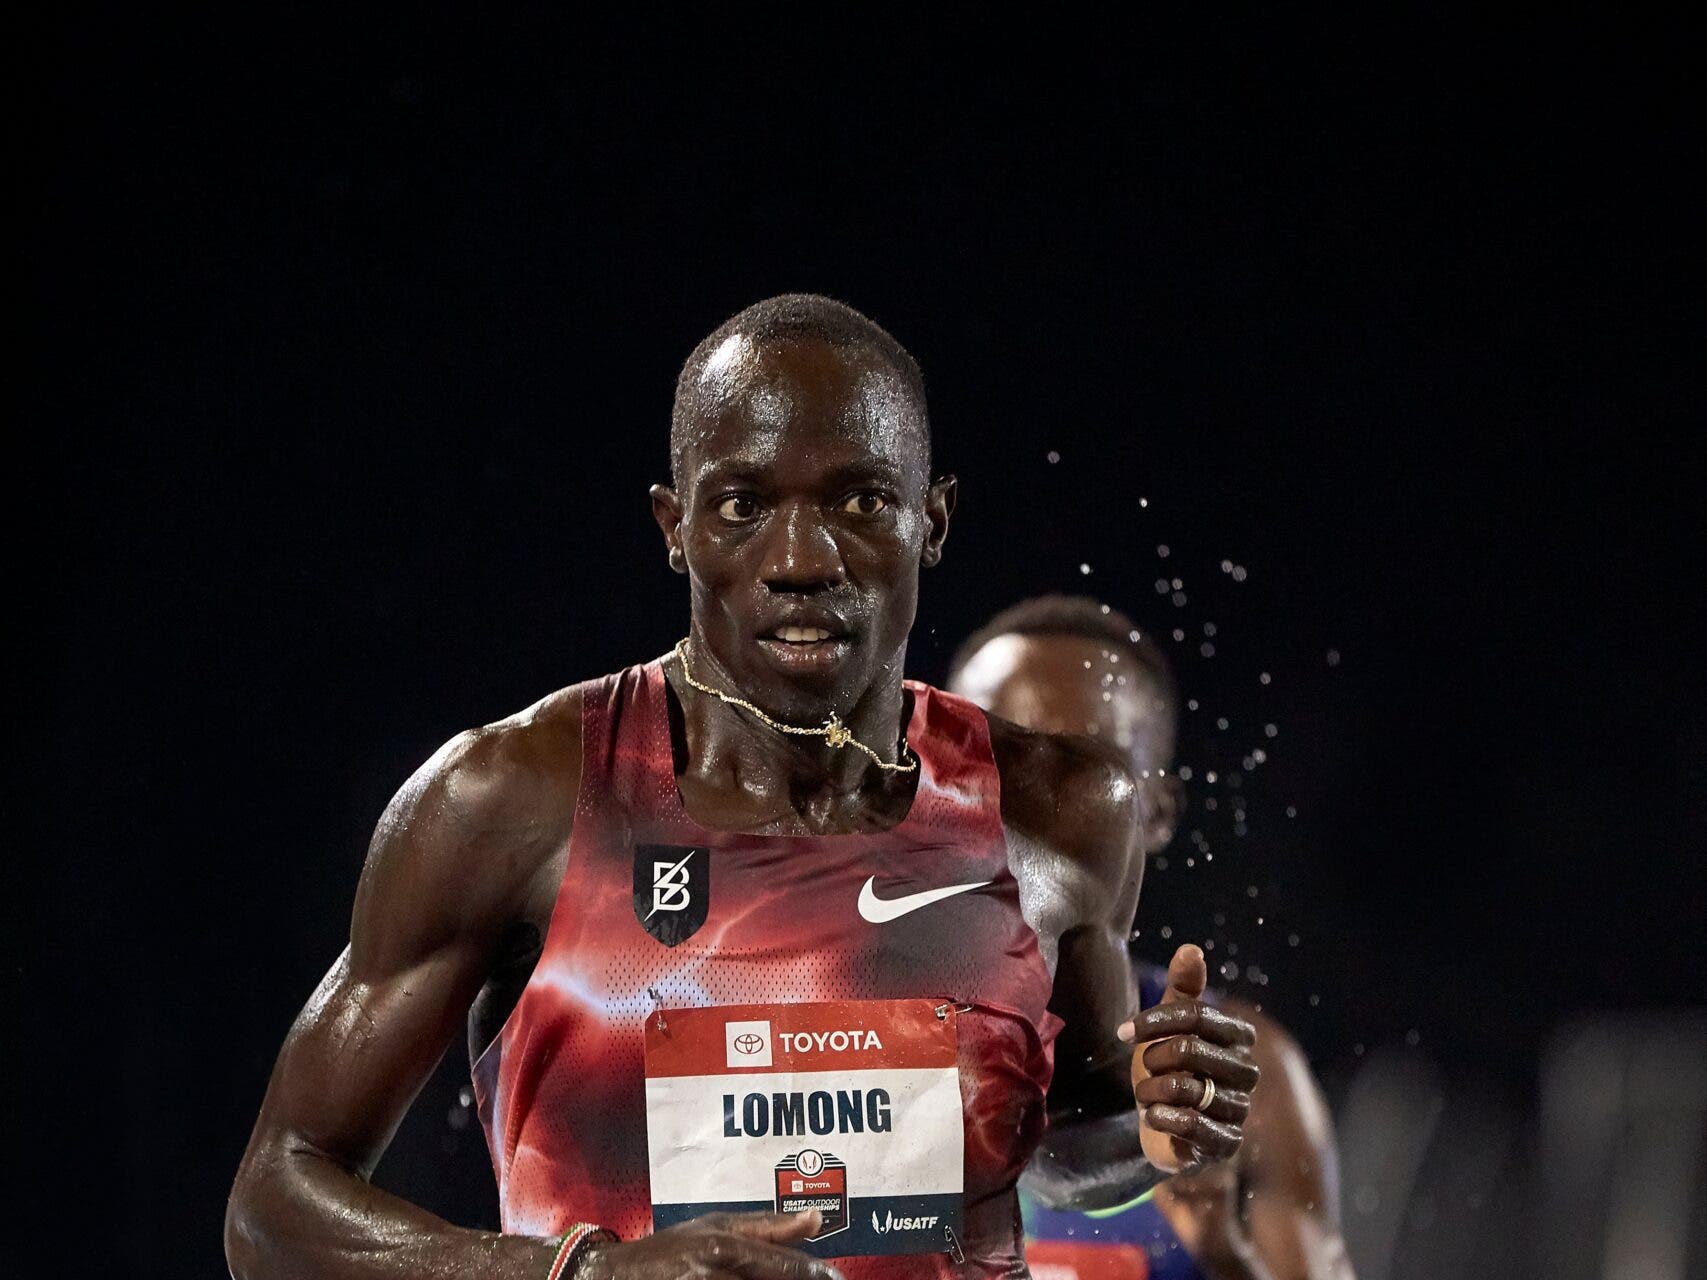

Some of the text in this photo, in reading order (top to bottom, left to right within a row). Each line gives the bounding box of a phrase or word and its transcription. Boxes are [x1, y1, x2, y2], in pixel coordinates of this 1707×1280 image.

[779, 1030, 883, 1053] TOYOTA
[722, 1088, 892, 1138] LOMONG
[807, 1198, 841, 1206] OUTDOOR
[892, 1216, 939, 1231] USATF
